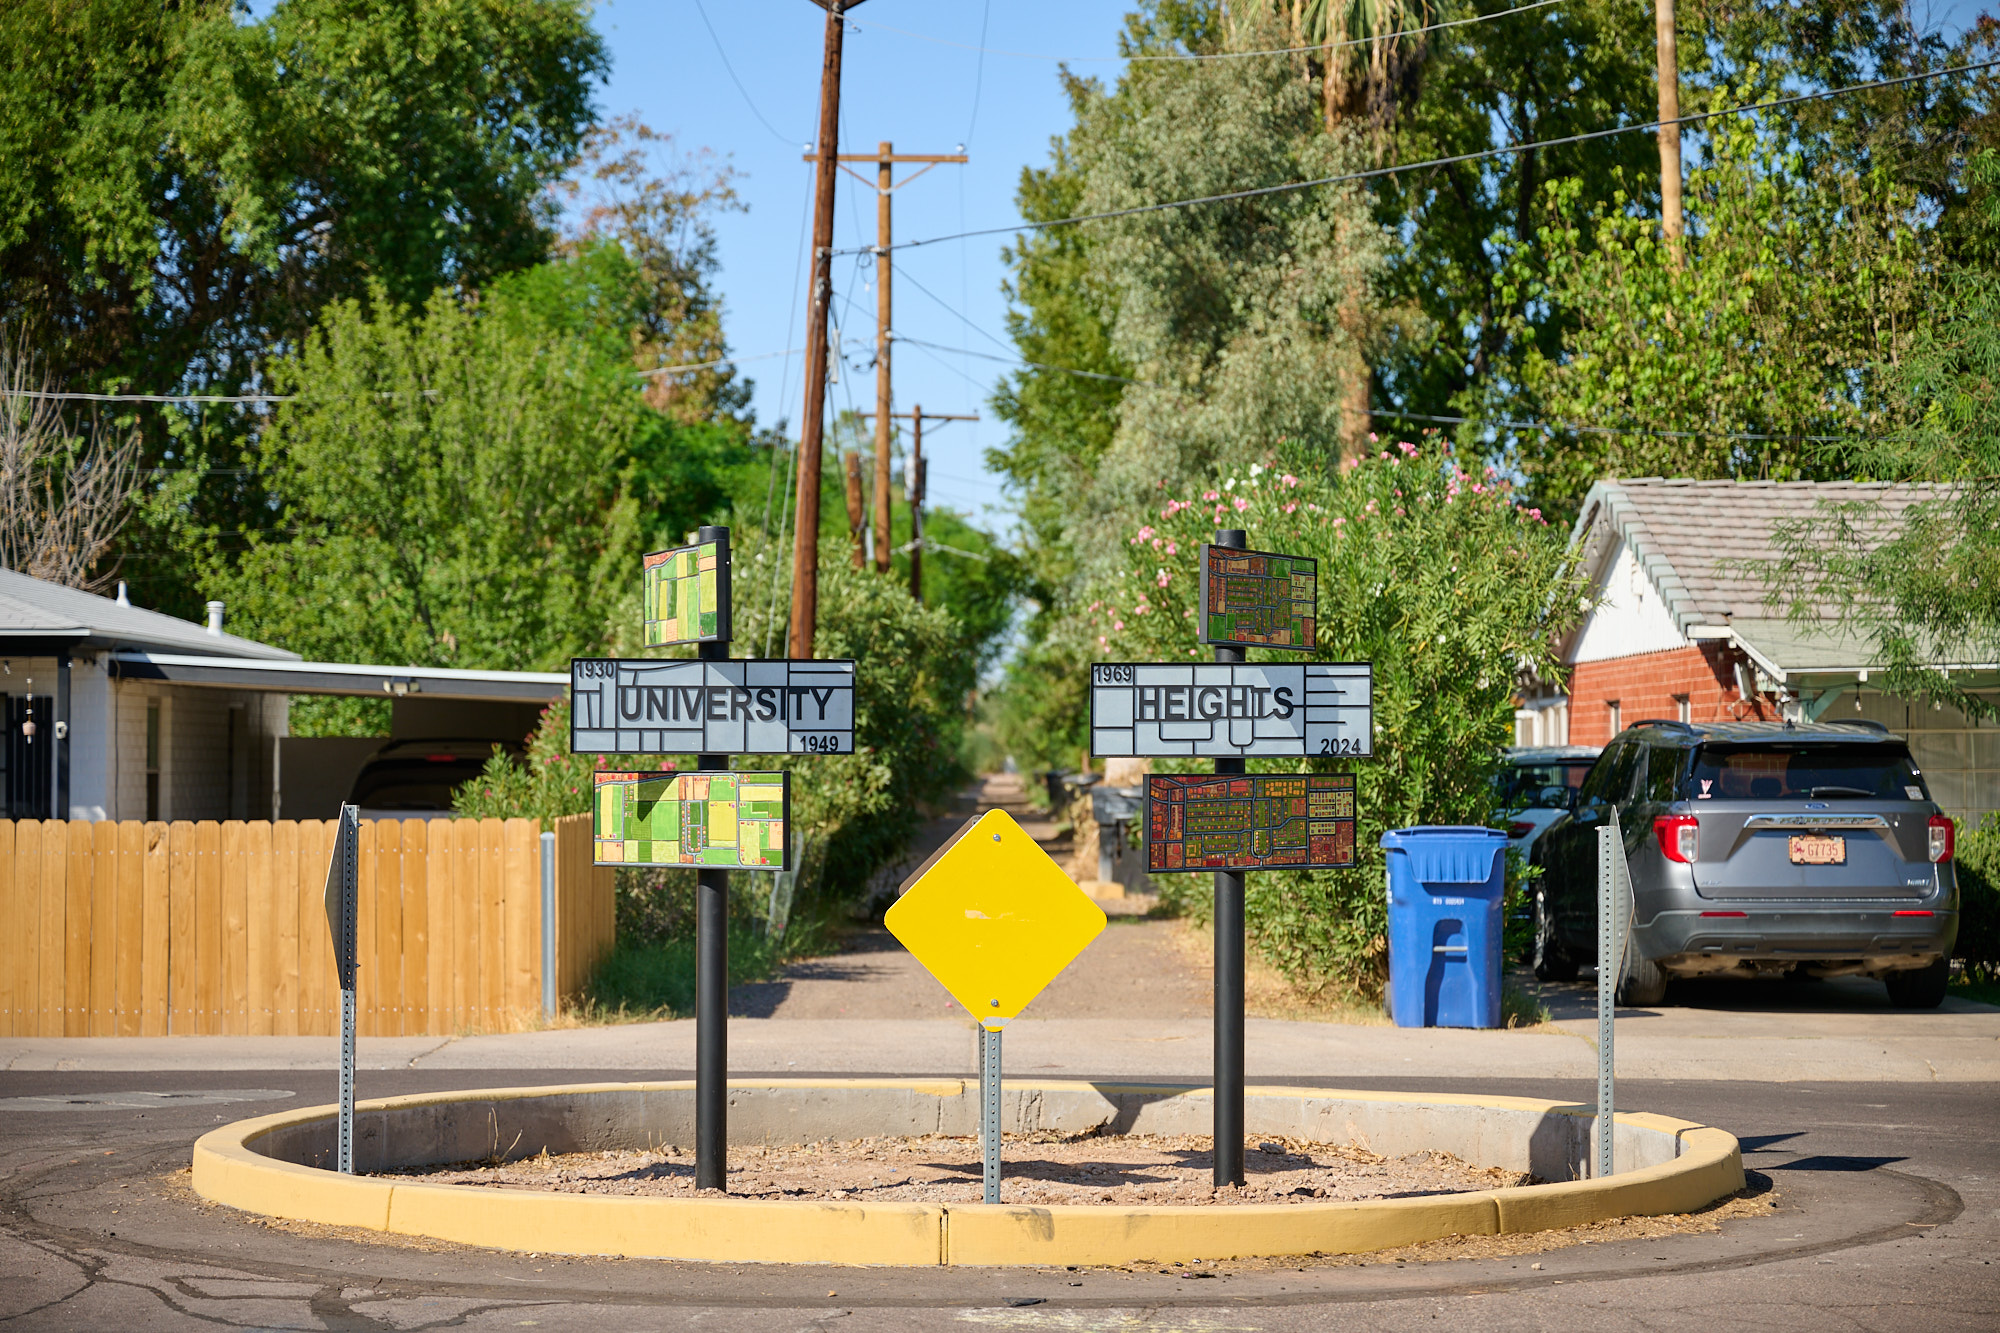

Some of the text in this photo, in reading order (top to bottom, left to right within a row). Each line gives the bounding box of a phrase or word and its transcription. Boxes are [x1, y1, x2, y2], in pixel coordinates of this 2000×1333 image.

[575, 661, 614, 678] 1930
[1094, 666, 1132, 682] 1969
[620, 687, 834, 721] UNIVERSITY
[1139, 686, 1293, 720] HEIGHTS
[800, 735, 839, 752] 1949
[1320, 738, 1361, 754] 2024
[1807, 843, 1838, 856] G7735
